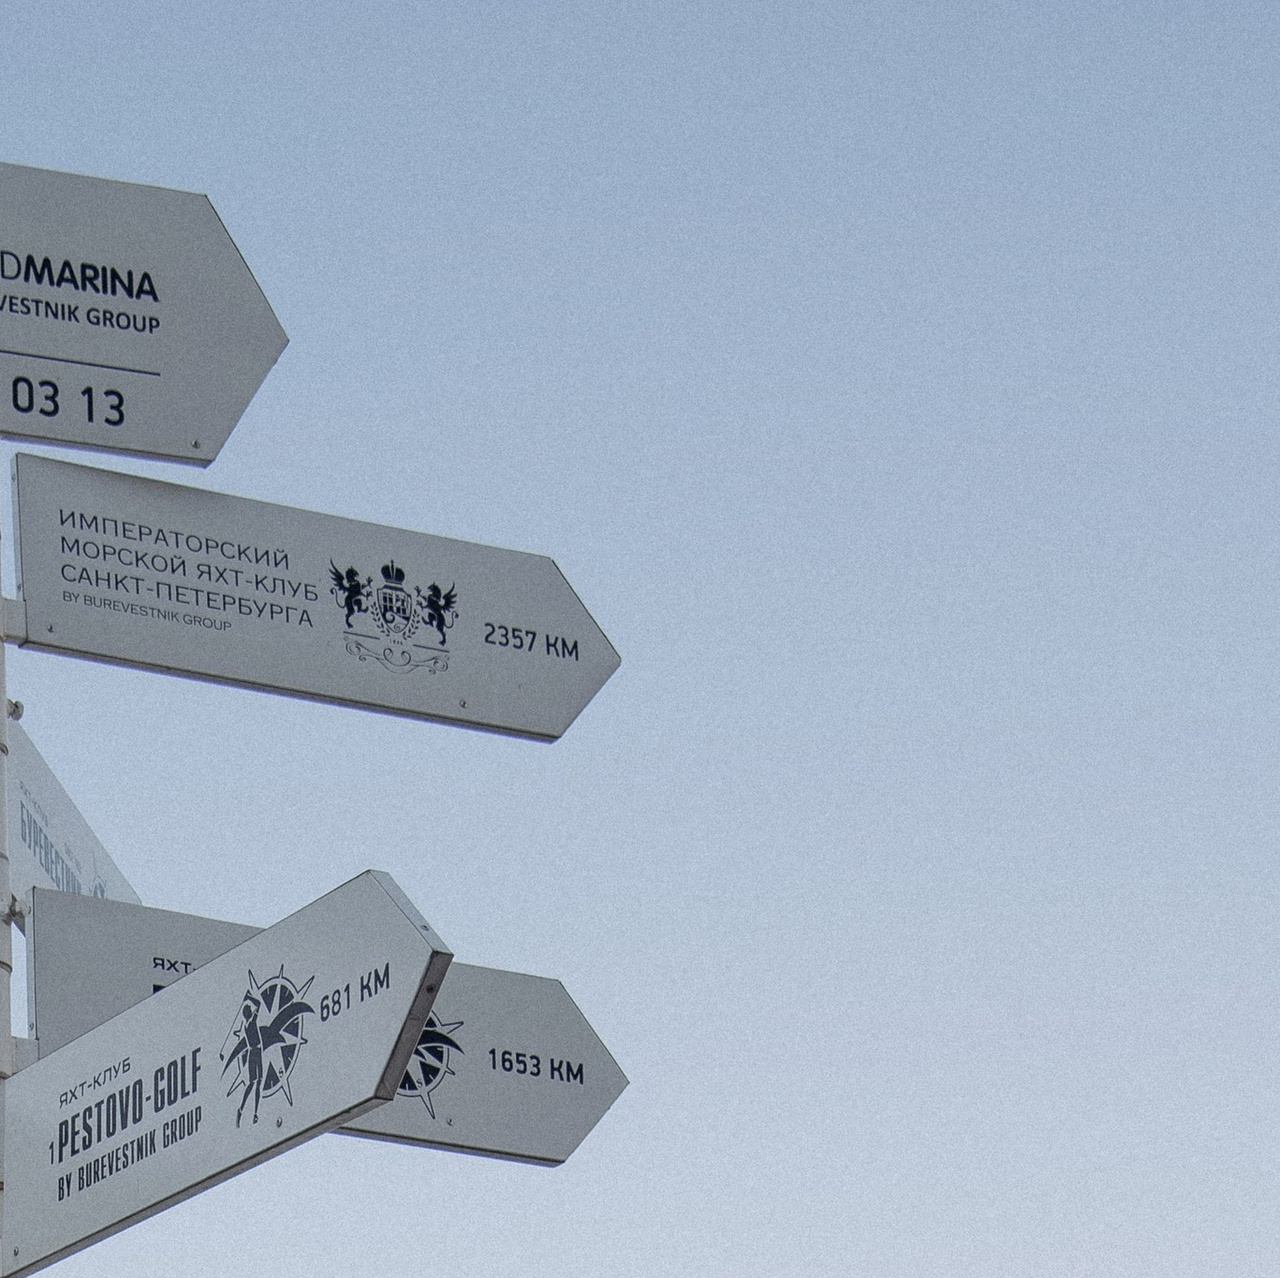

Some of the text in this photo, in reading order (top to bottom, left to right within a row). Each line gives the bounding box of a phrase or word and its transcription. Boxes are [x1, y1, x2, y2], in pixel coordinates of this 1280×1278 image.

[87, 309, 161, 334] GROUP
[12, 378, 60, 417] 03
[80, 387, 125, 427] 13
[59, 509, 289, 570] ИМПЕРАТОРСКИЙ
[61, 536, 318, 601] МОРСКОЙ ЯХТ-КЛУБ
[61, 564, 313, 627] САНКТ-ПЕТЕРБУРГА
[62, 591, 232, 631] BY BUREVESTNIK GROUP
[484, 623, 537, 652] 2357
[320, 983, 350, 1022] 681
[59, 1057, 131, 1108] ЯХТ-КЛУБ
[488, 1048, 541, 1077] 1653
[58, 1106, 202, 1201] BY BUREVESTNIK GROUP
